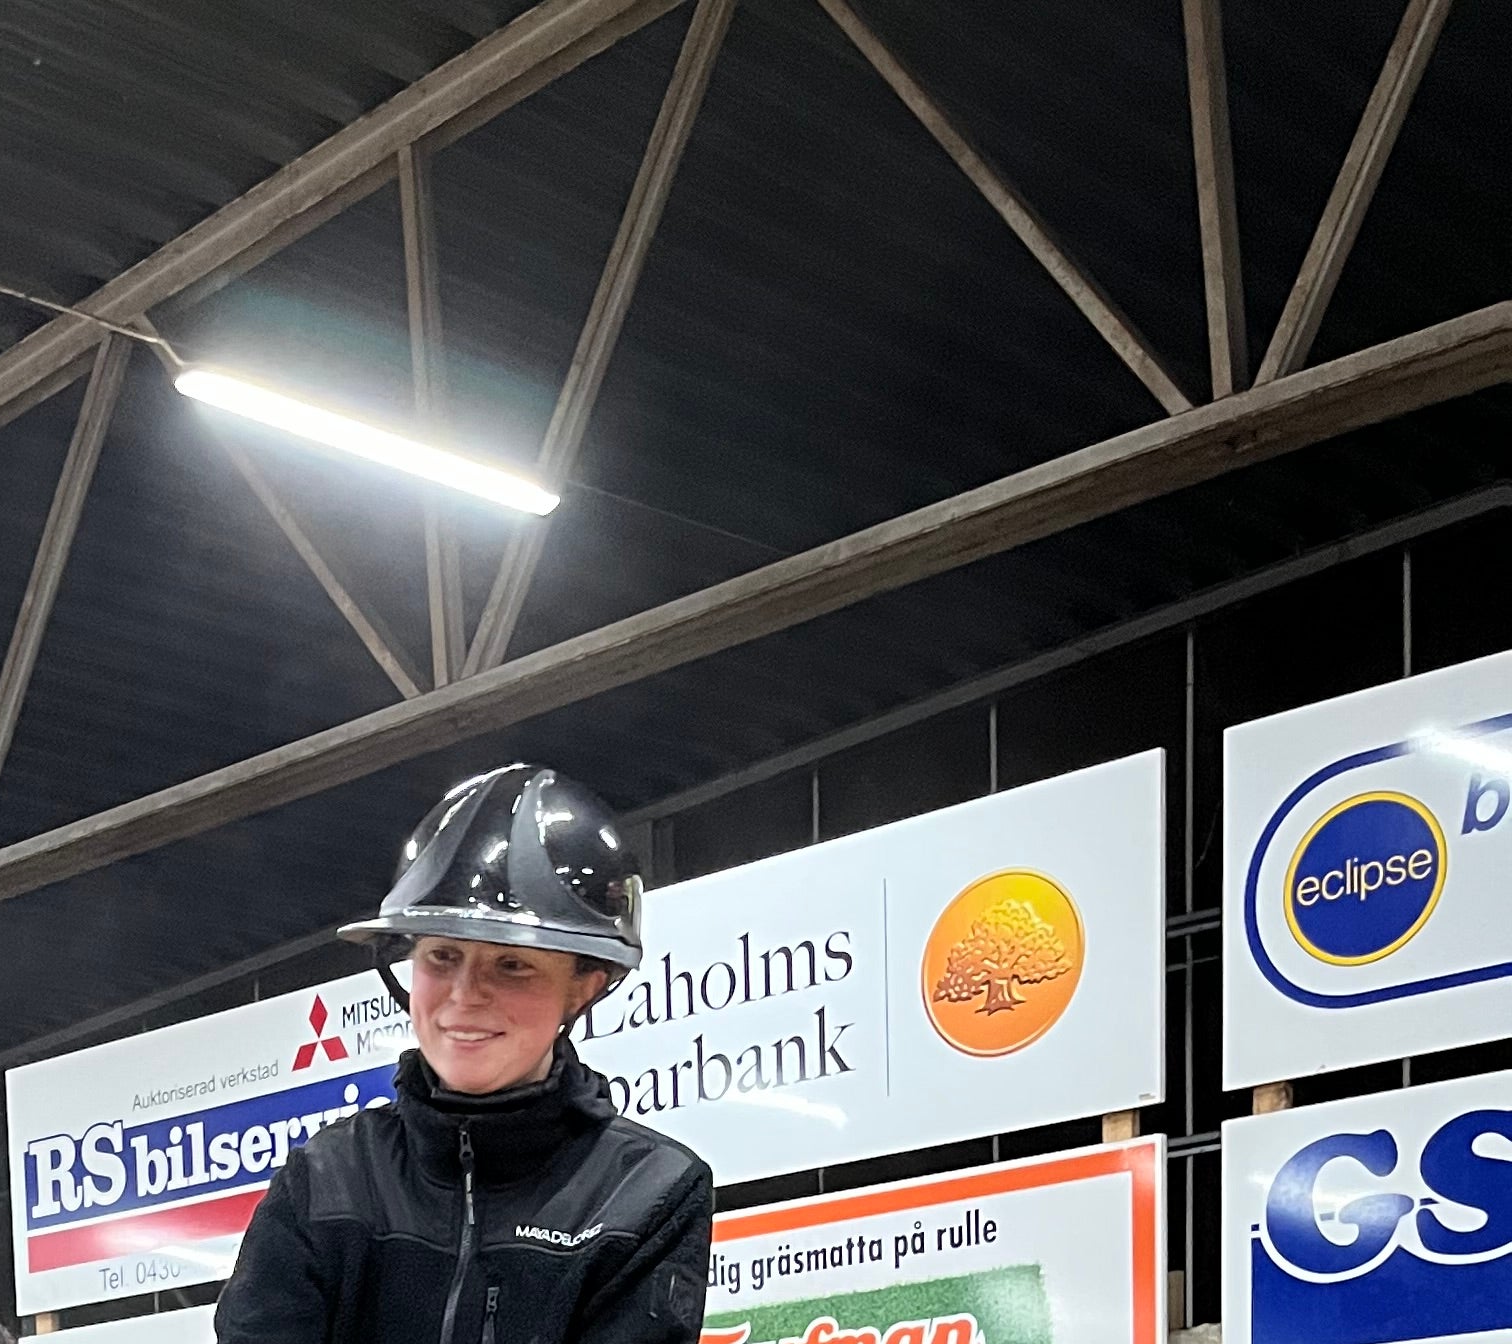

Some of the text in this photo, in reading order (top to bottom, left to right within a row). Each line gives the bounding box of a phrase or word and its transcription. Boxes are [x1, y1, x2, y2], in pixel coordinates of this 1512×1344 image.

[1295, 848, 1433, 907] eclipse
[578, 931, 853, 1043] Laholms
[131, 1060, 279, 1112] Auktoriserad verkstad
[28, 1119, 127, 1219] RS
[751, 1235, 883, 1290] gräsmatta
[894, 1221, 925, 1269] på
[937, 1209, 997, 1251] rulle
